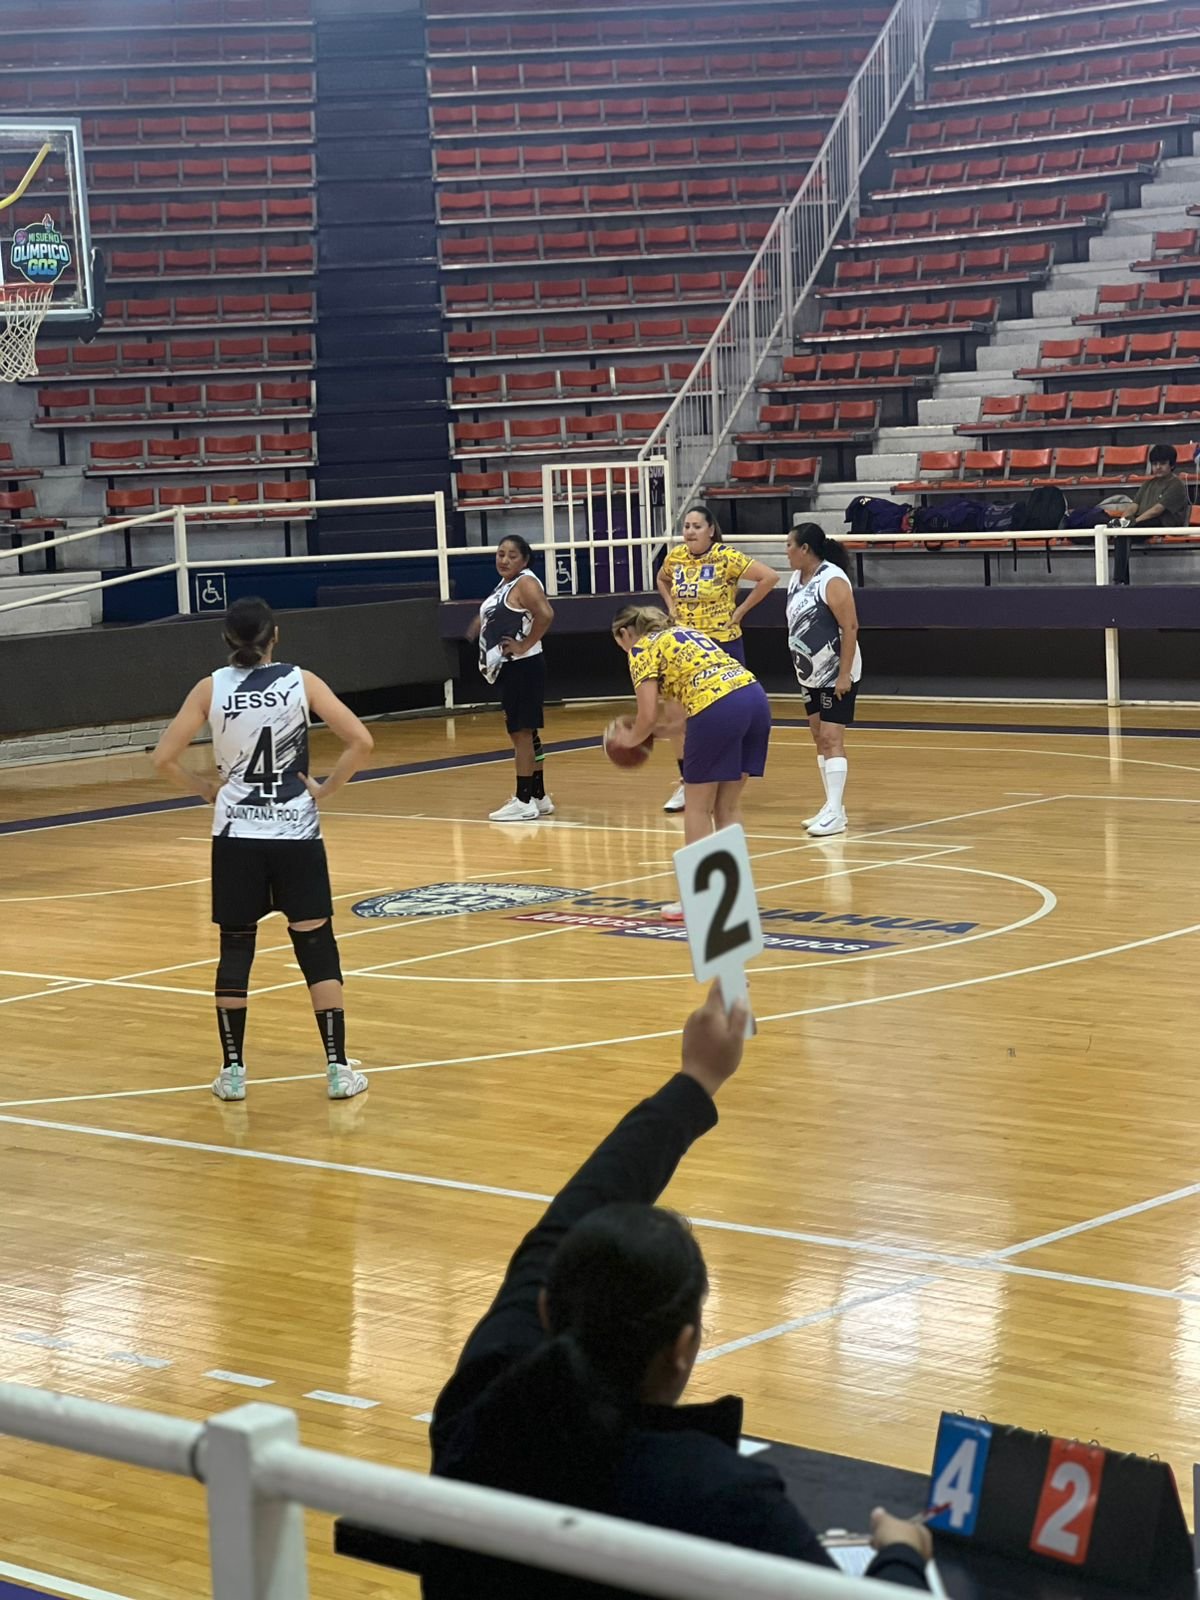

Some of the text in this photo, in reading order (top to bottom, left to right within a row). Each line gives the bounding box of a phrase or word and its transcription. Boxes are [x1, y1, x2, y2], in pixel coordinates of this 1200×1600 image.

[677, 583, 698, 599] 23
[684, 630, 718, 651] 6
[222, 691, 290, 711] JESSY
[243, 726, 282, 797] 4
[225, 805, 299, 822] QUINTANA ROO
[571, 897, 980, 934] CHAHUA
[693, 849, 752, 964] 2
[932, 1438, 978, 1529] 4
[1036, 1461, 1092, 1557] 2
